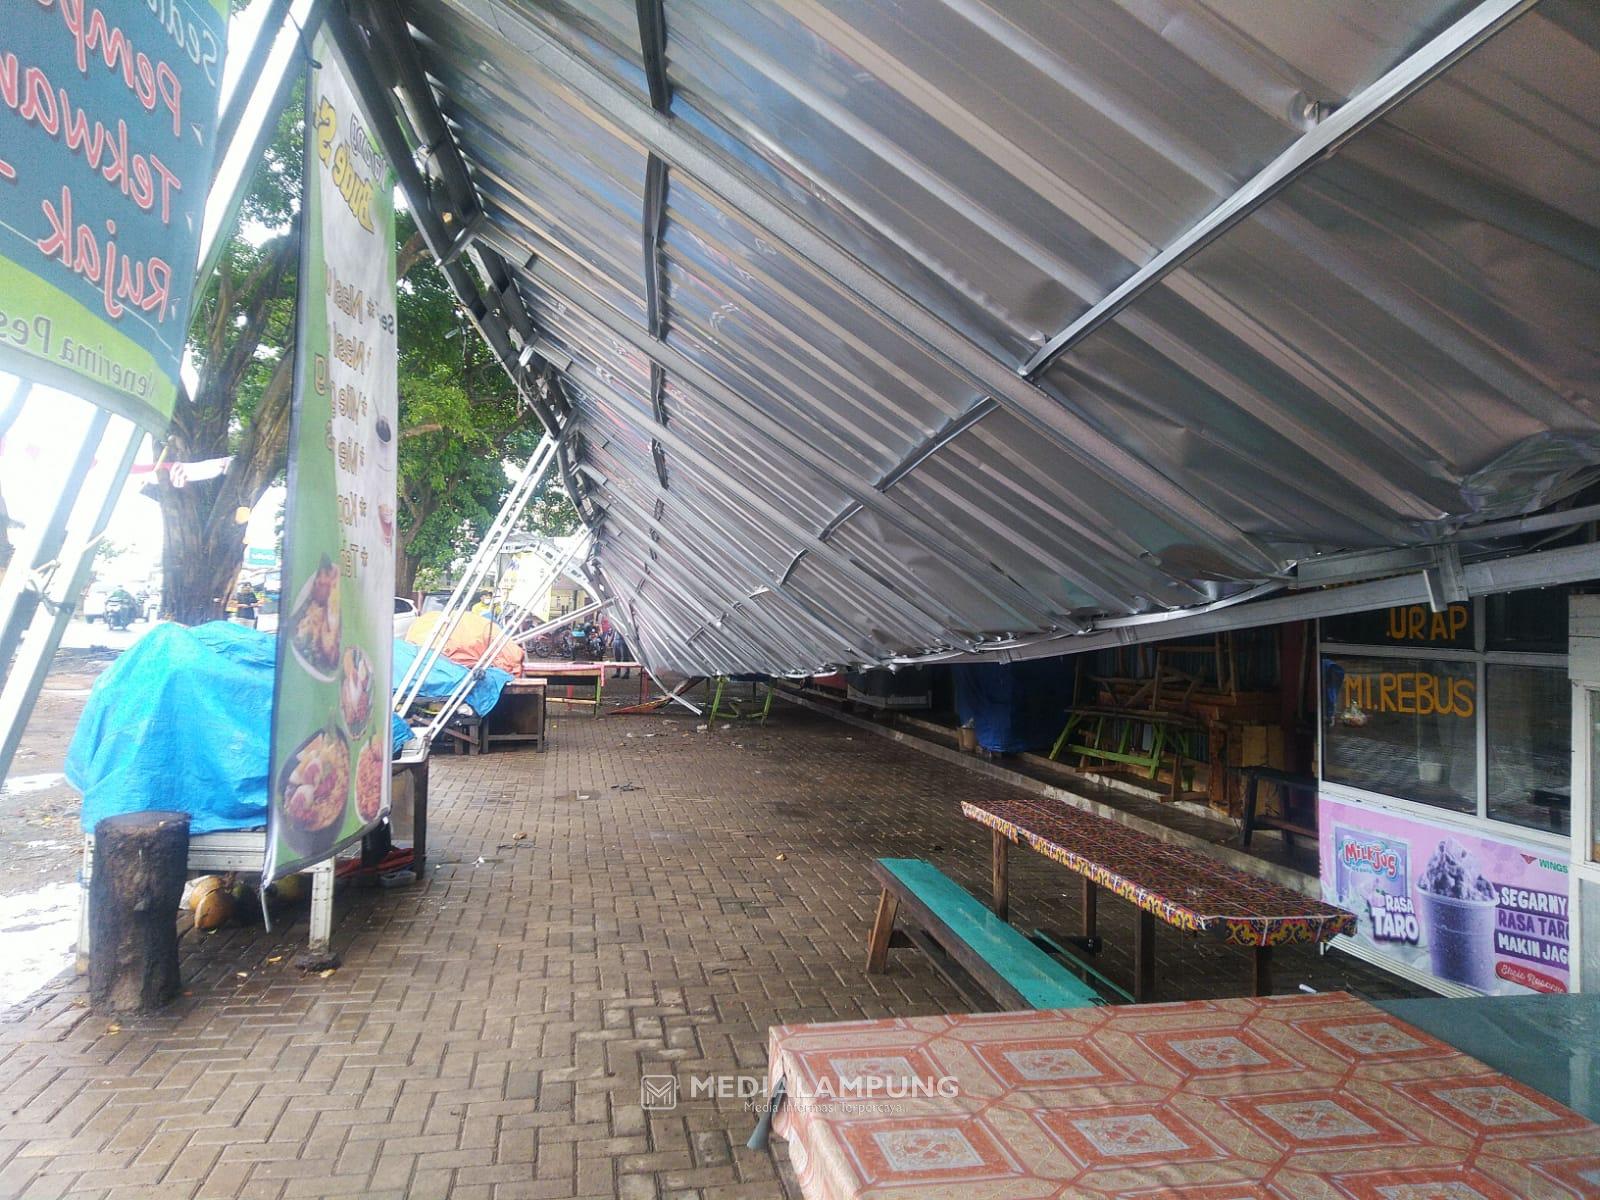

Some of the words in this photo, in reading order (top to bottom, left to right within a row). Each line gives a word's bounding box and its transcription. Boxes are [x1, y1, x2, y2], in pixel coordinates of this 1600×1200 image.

[1539, 859, 1569, 874] WINGS
[1385, 894, 1415, 915] RASA
[1371, 906, 1420, 941] TARO
[1498, 909, 1535, 934] RASA
[1498, 932, 1540, 960] MAKIN
